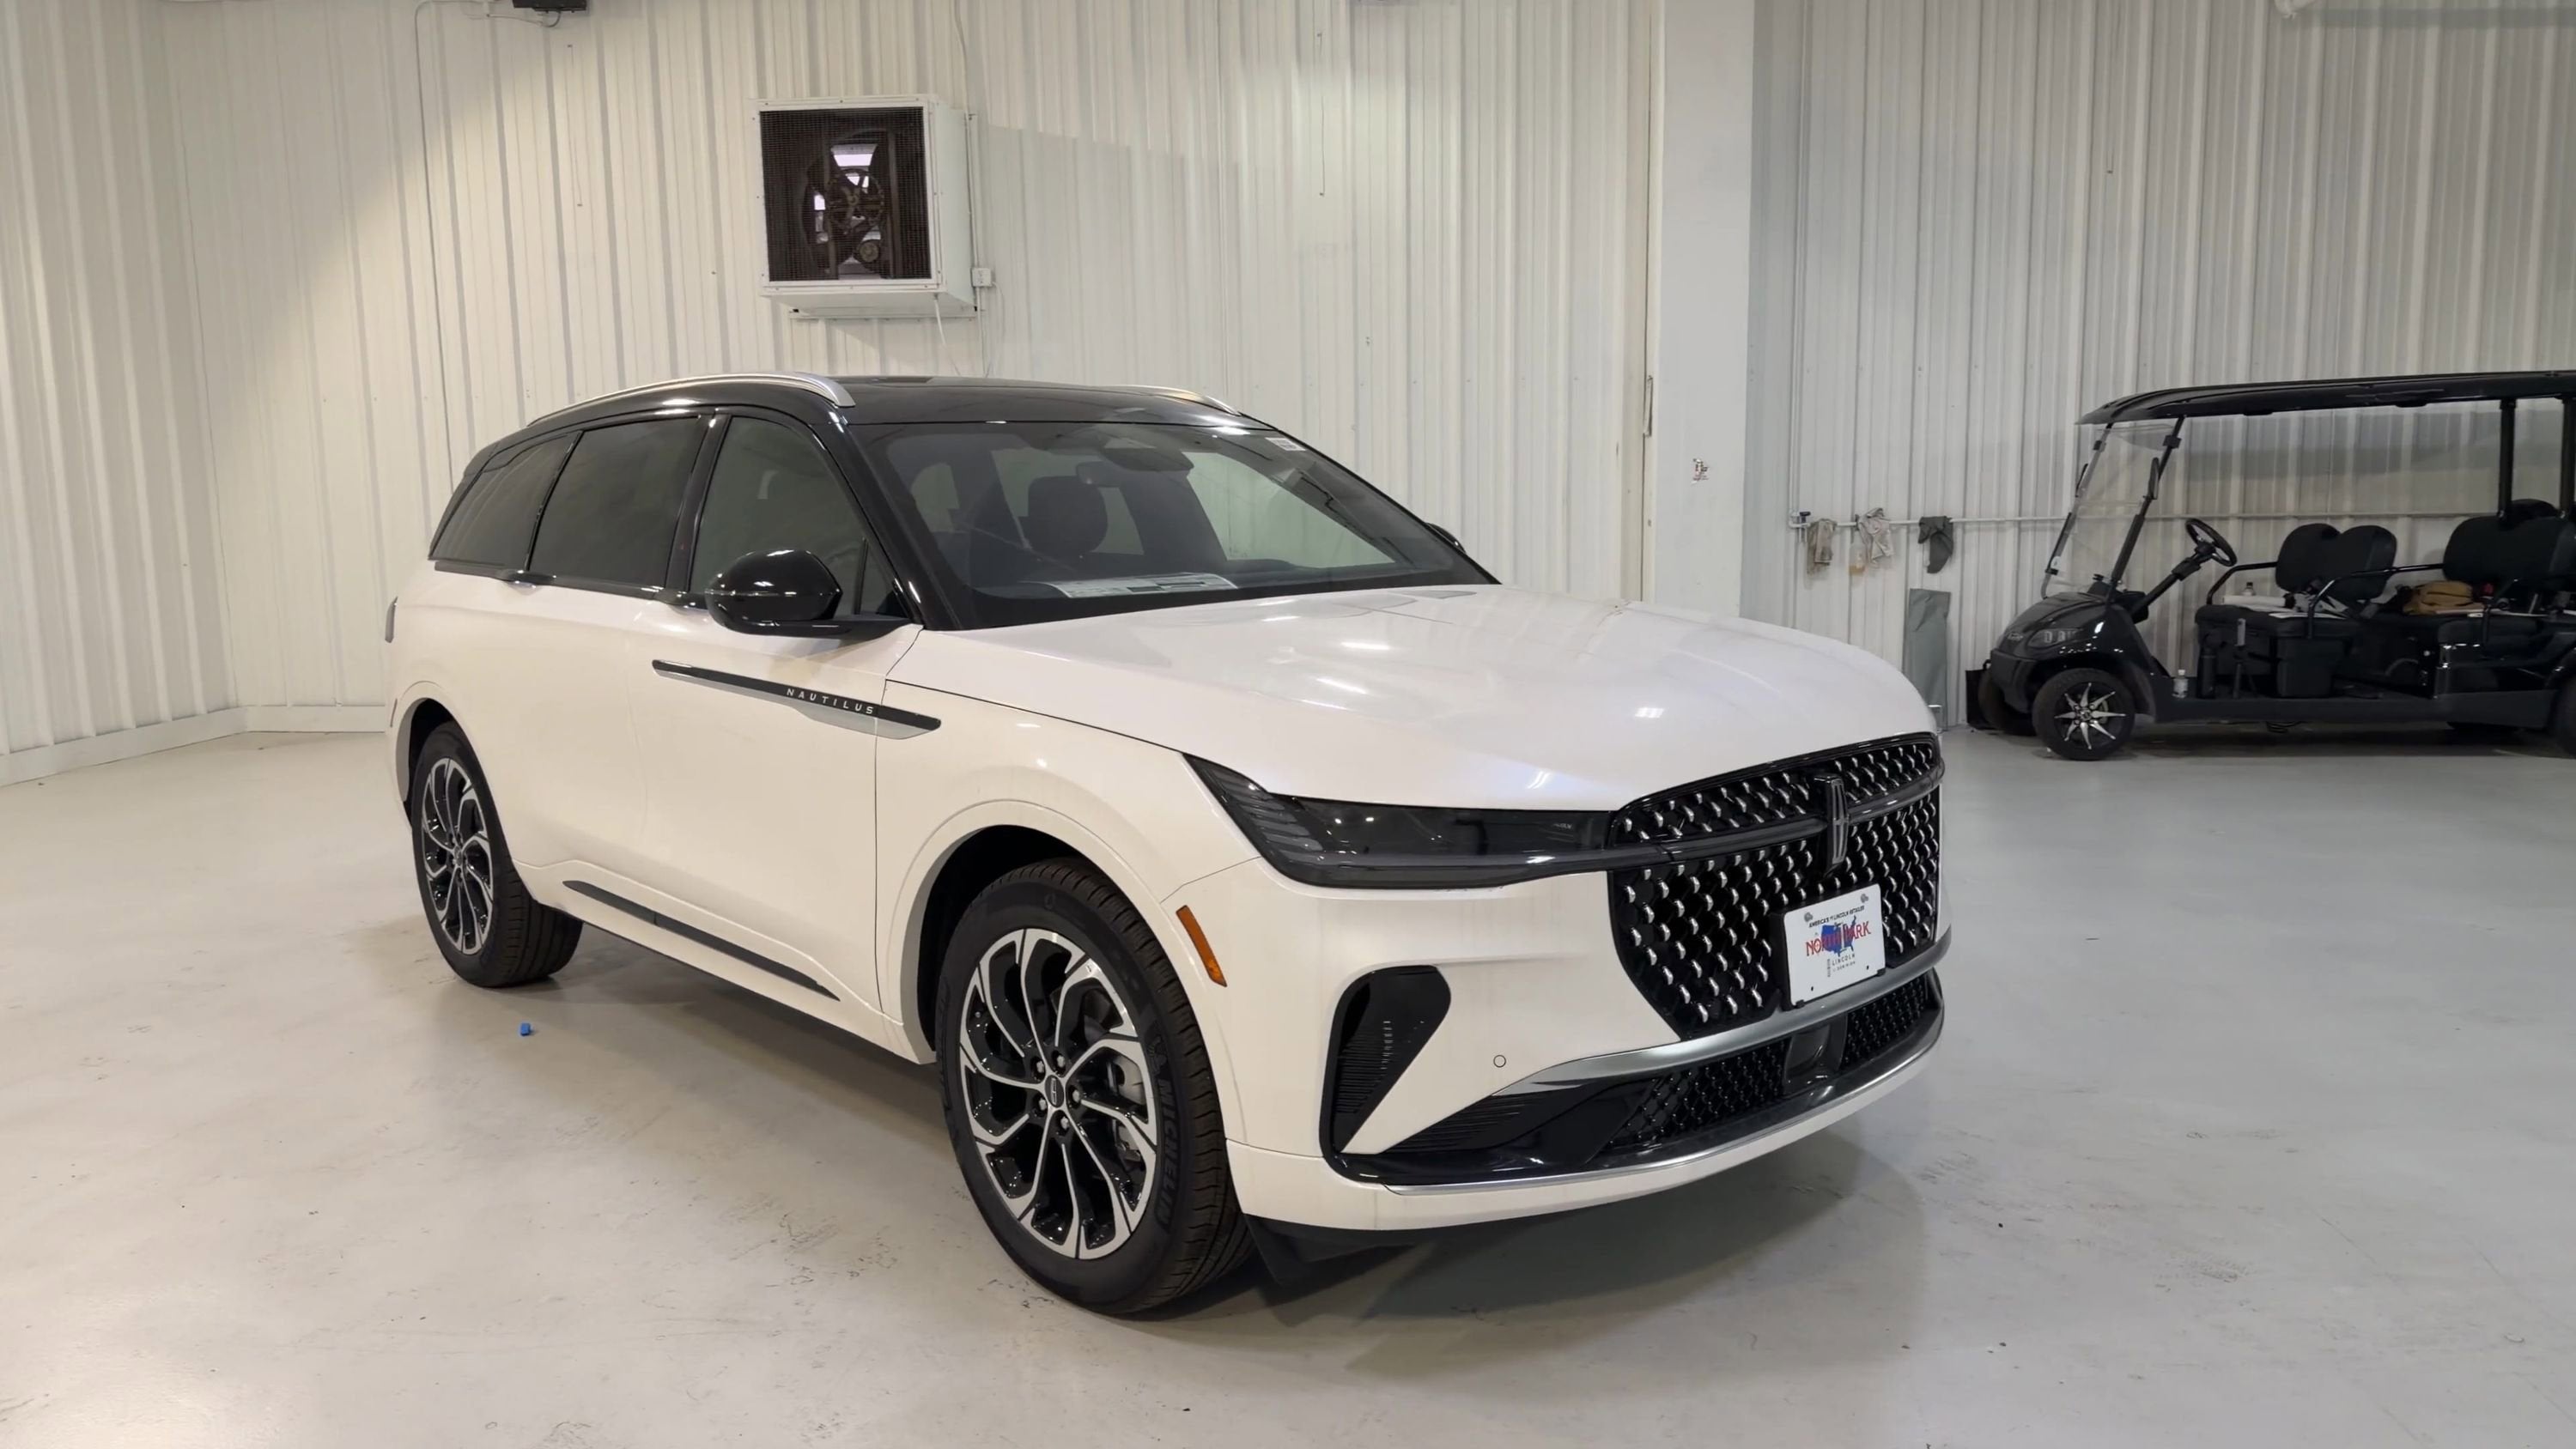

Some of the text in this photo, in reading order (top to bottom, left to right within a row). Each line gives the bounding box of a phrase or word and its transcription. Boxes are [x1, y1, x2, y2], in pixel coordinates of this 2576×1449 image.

[787, 688, 874, 714] NAUTILUS
[1809, 917, 1829, 928] AMERICA'S
[1833, 911, 1849, 920] LINCOLN
[1806, 921, 1871, 956] NORTH PARK
[1832, 954, 1855, 966] LINCOLN
[1157, 1078, 1179, 1228] MICHELIN
